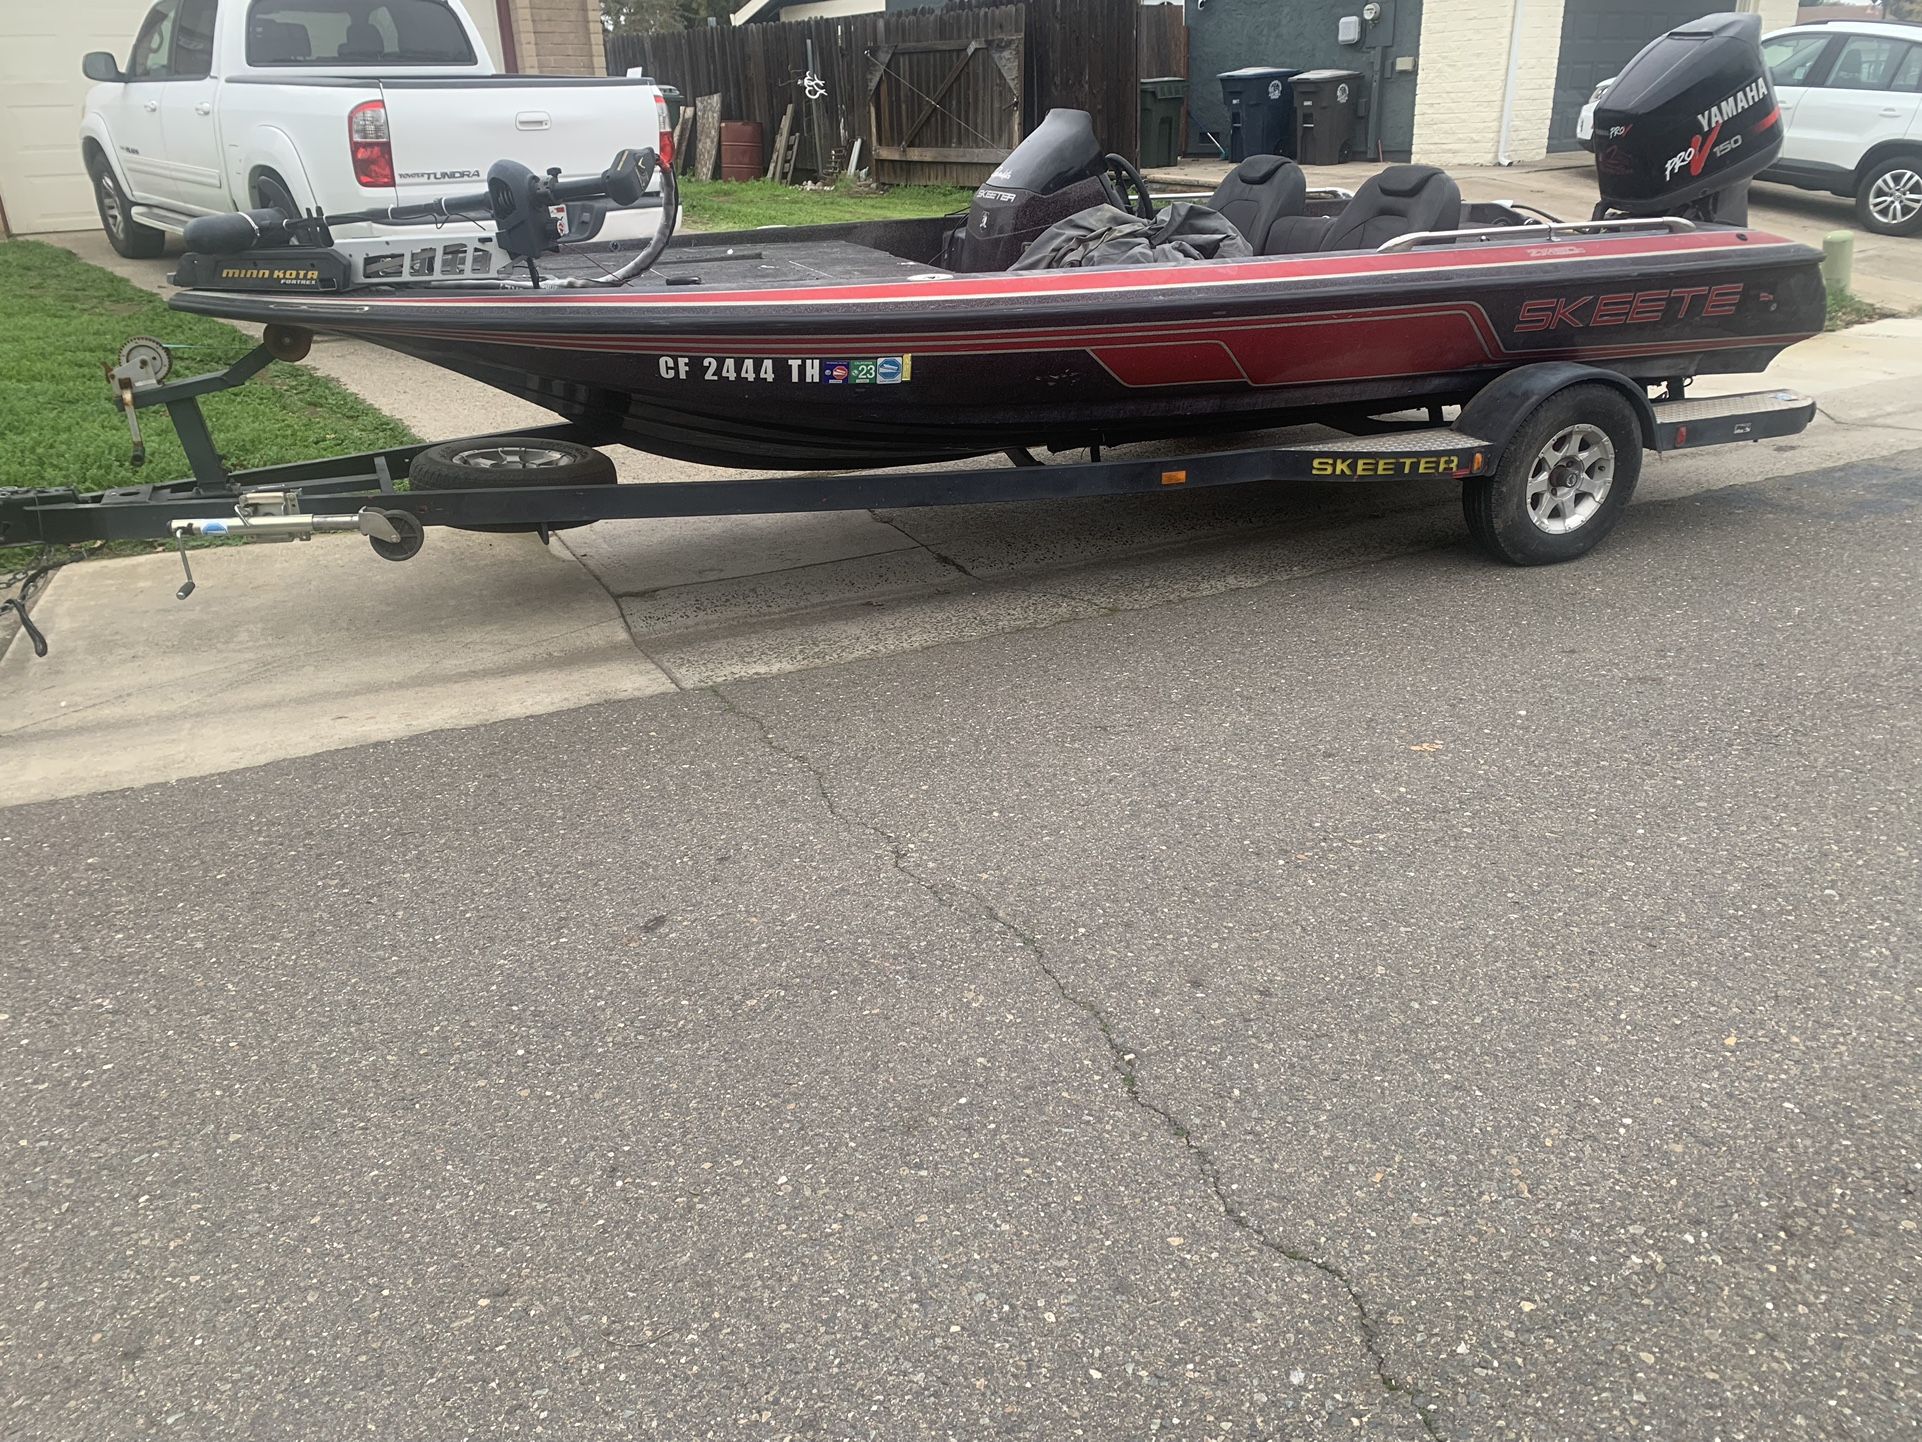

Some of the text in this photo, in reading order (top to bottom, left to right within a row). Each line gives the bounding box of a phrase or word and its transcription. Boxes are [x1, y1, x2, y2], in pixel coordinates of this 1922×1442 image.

[1696, 77, 1768, 132] YAMAHA
[1713, 135, 1743, 157] 150
[423, 169, 480, 180] TUNDRA
[976, 189, 1017, 203] SKEETER
[221, 268, 319, 279] MINN KOTA
[658, 356, 820, 383] CF 2444 TH
[858, 365, 876, 379] 23
[1312, 455, 1459, 475] SKEETER
